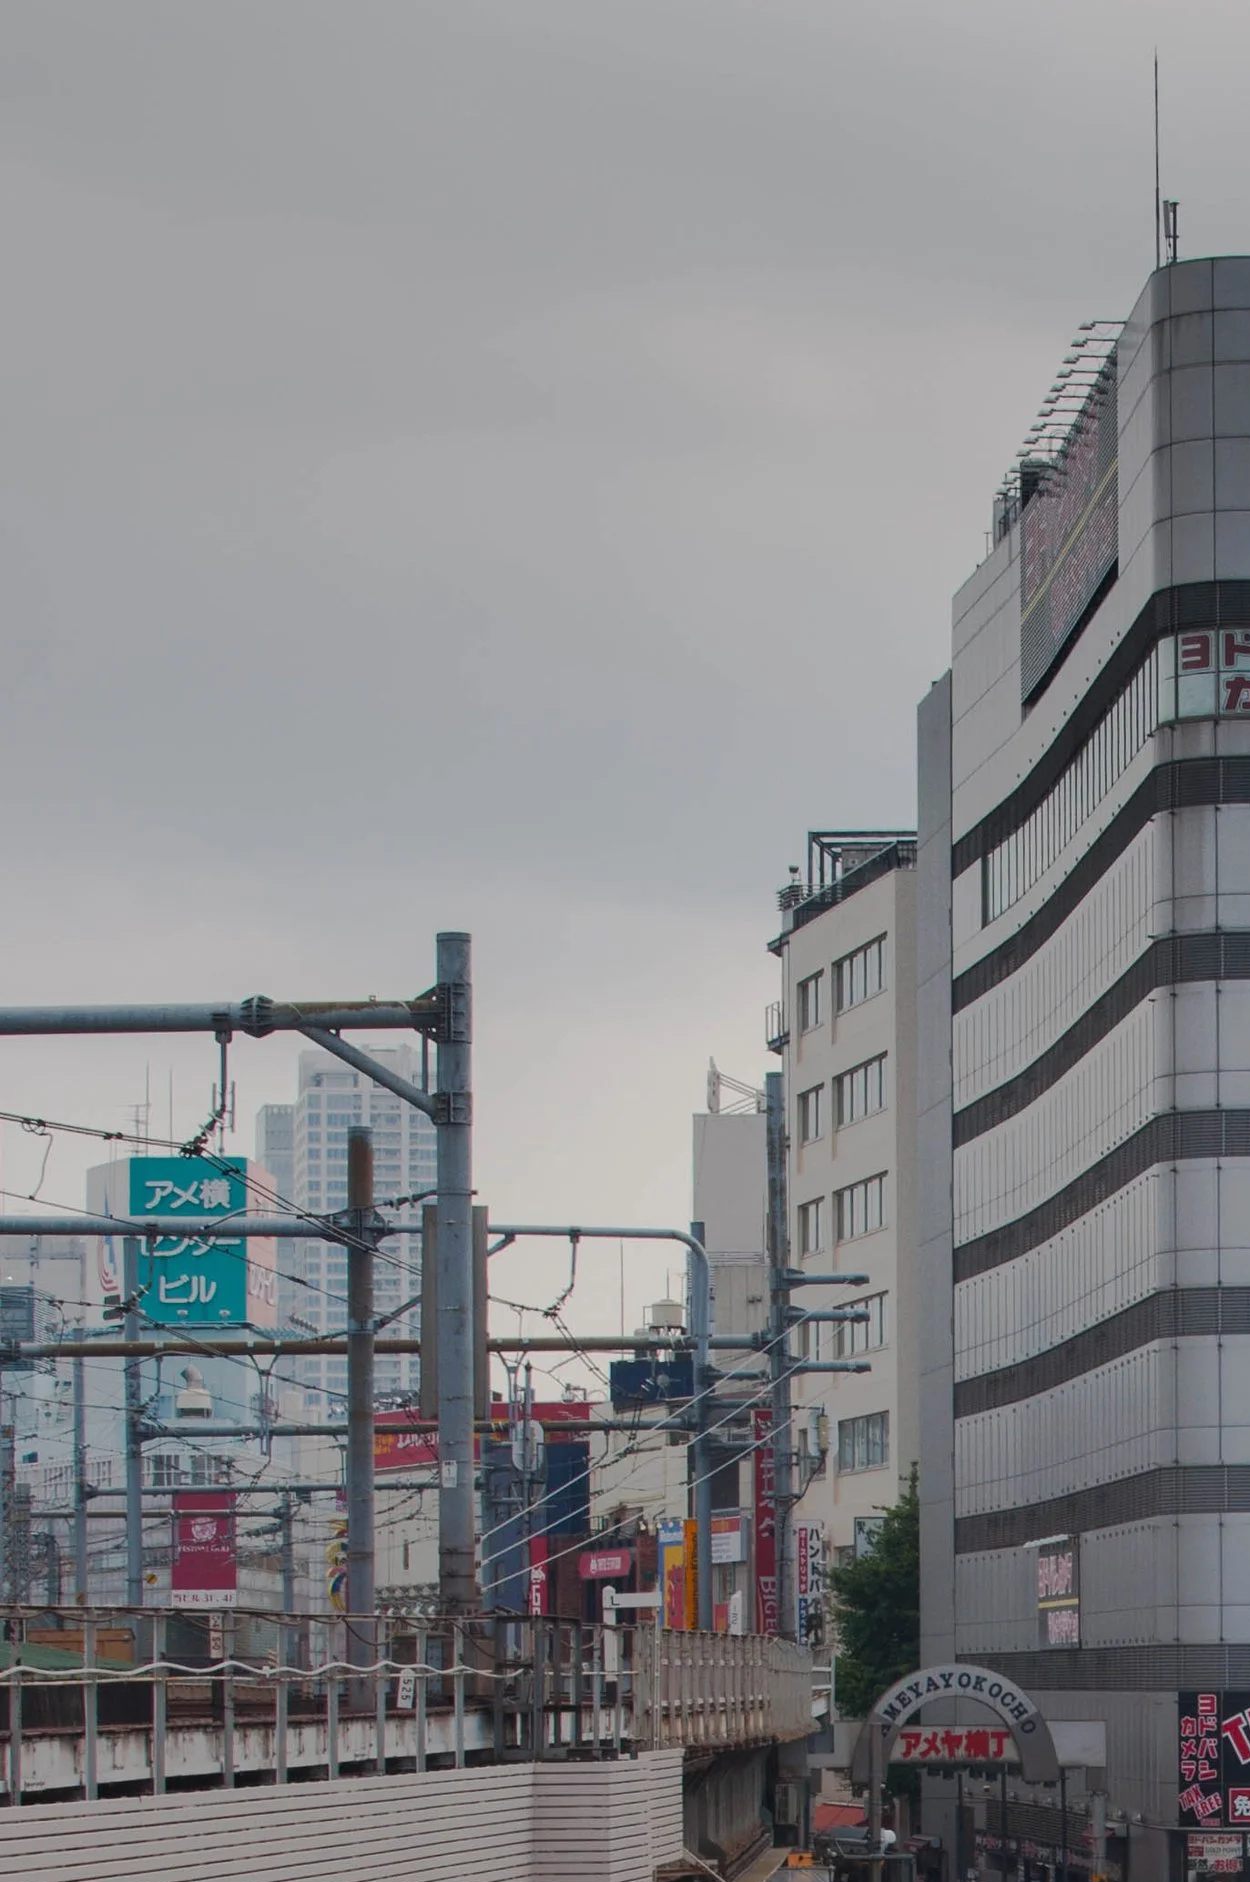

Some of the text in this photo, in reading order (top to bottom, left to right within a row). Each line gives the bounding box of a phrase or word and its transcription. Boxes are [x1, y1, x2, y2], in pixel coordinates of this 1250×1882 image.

[144, 1178, 232, 1209] アメ横
[158, 1274, 217, 1304] ビル
[880, 1672, 1037, 1738] AMEYAYOKOCHO
[900, 1729, 1010, 1759] アメヤ横丁
[1180, 1715, 1196, 1781] カメラ
[1198, 1694, 1217, 1781] ヨドバシ
